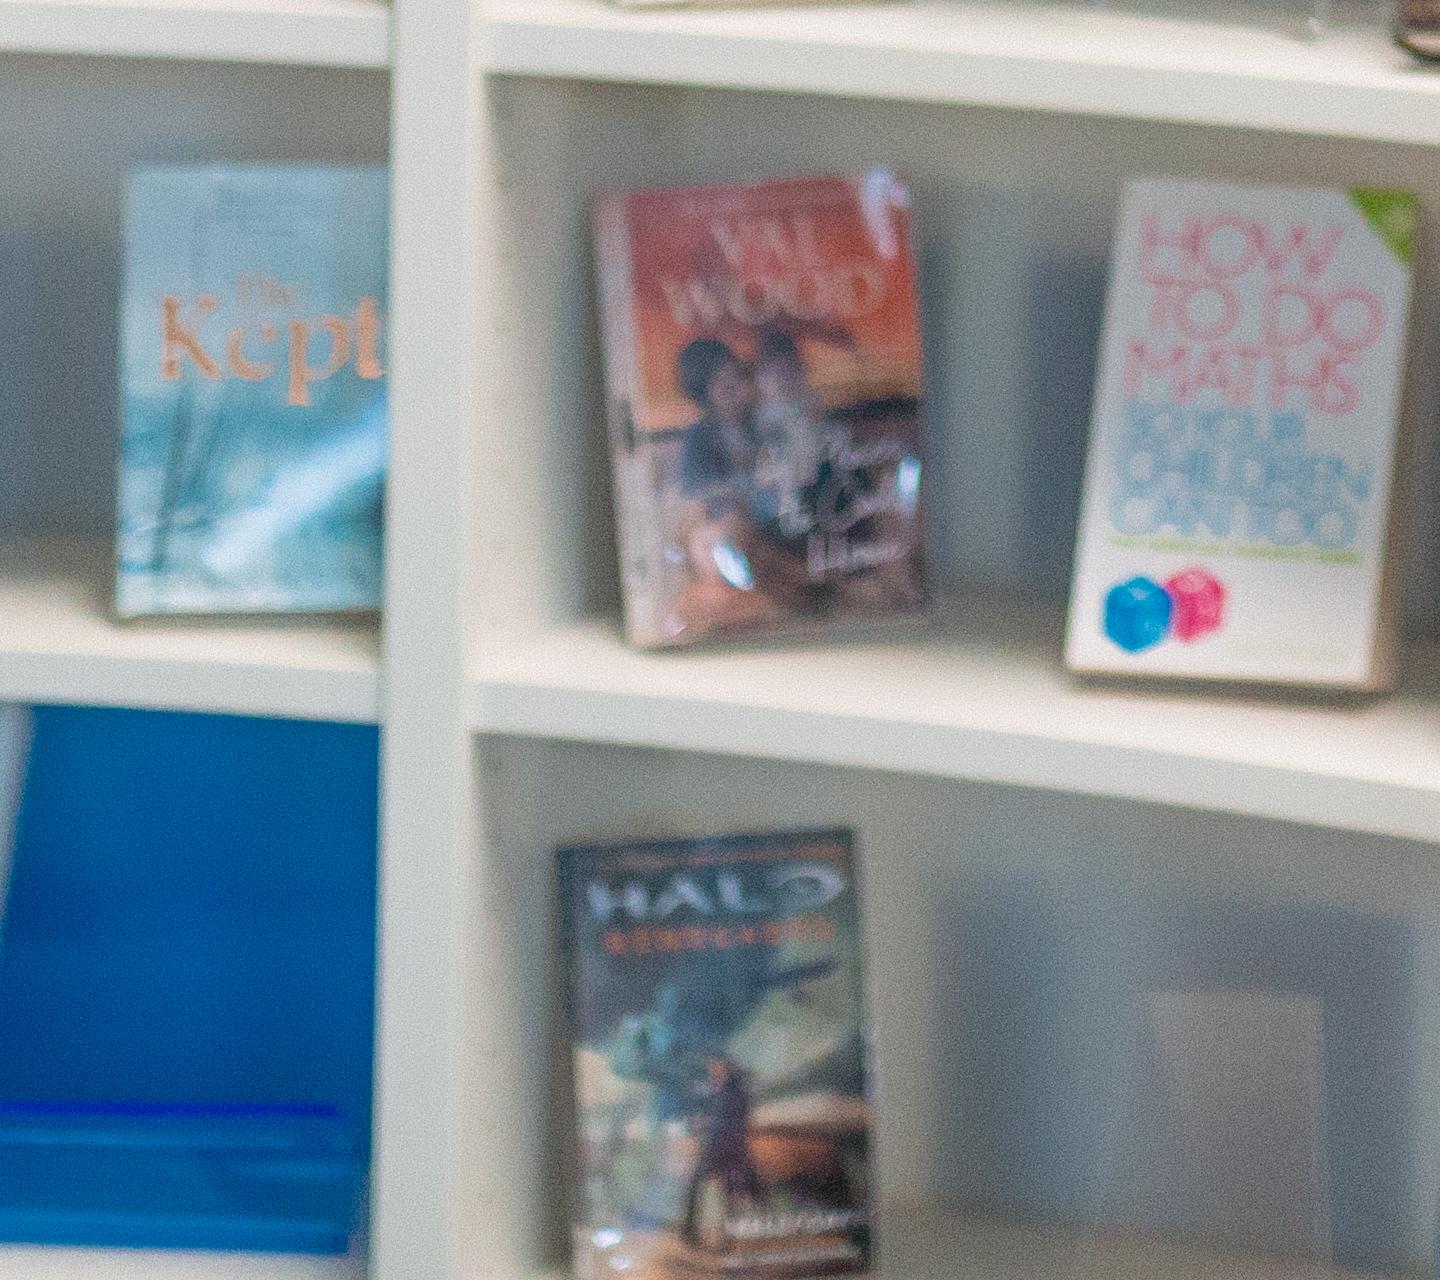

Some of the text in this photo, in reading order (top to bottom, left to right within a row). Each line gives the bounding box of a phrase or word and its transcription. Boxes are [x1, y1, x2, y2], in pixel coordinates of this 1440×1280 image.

[1138, 212, 1344, 283] HOW
[161, 293, 385, 407] Kept
[1142, 275, 1387, 353] TO DO
[1121, 338, 1362, 418] MATHS
[587, 861, 846, 921] HALO
